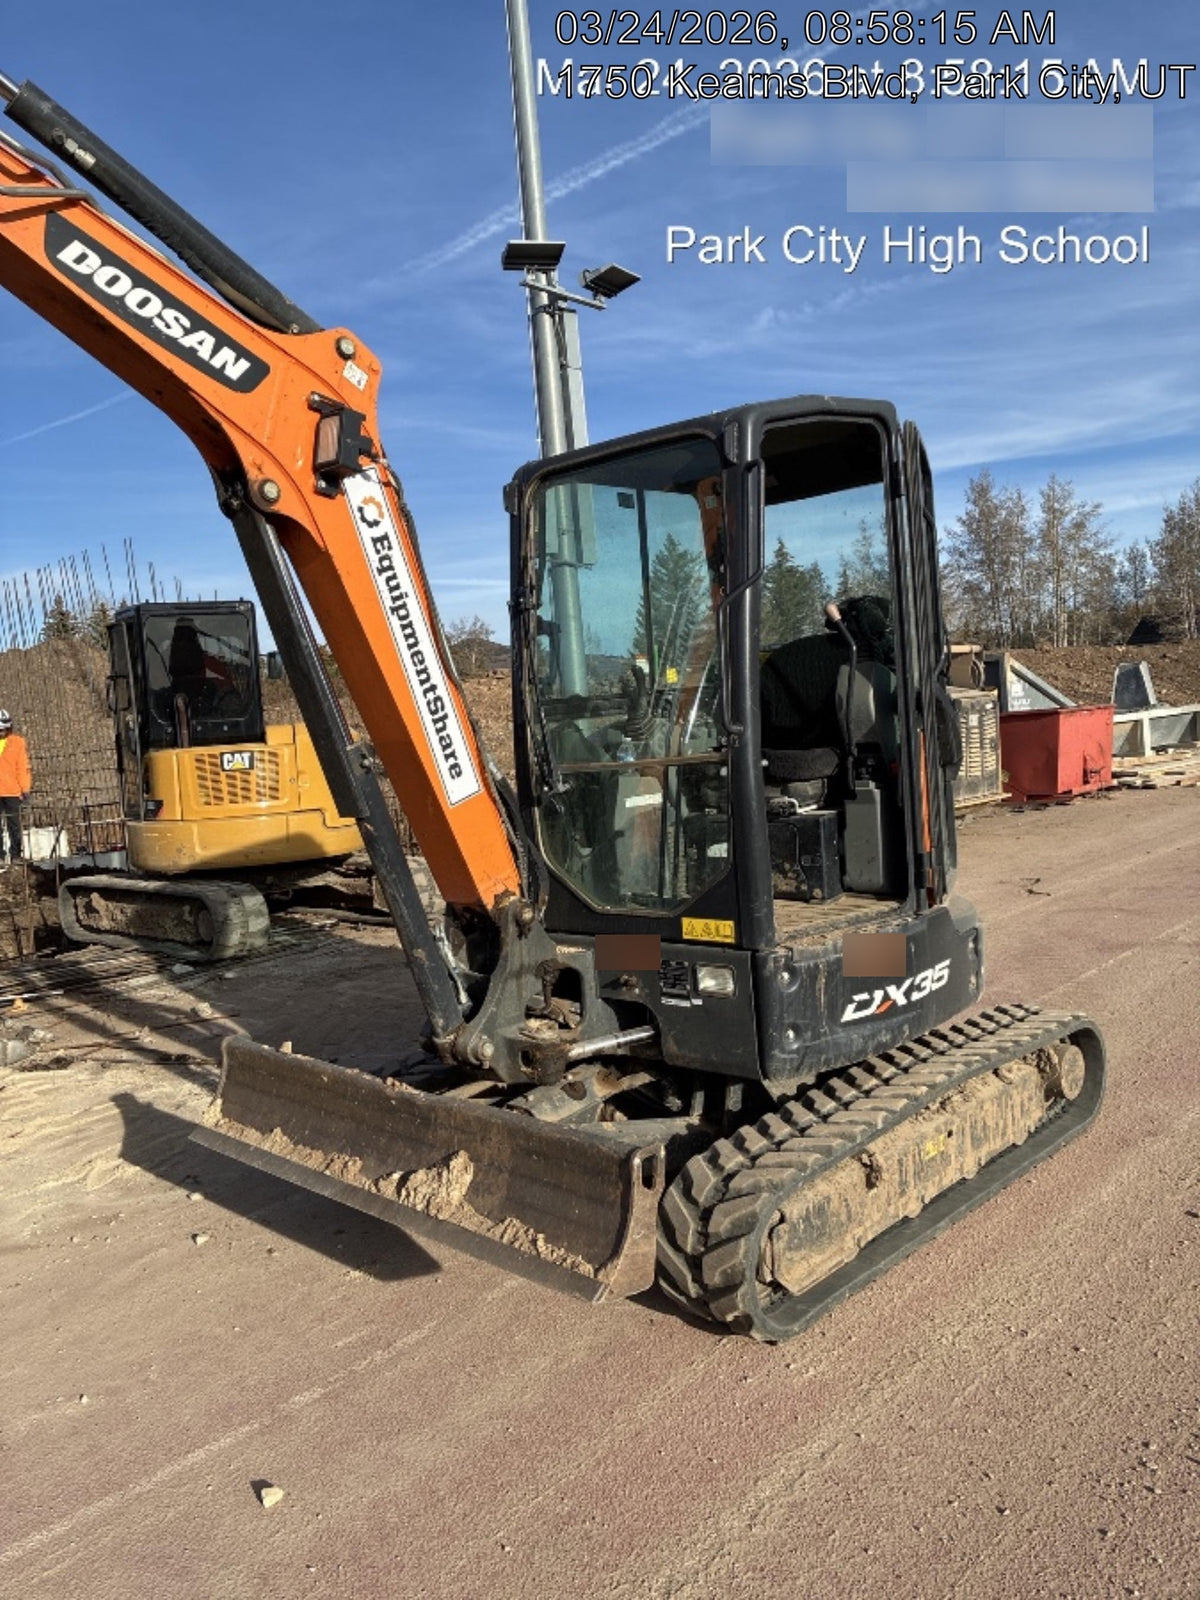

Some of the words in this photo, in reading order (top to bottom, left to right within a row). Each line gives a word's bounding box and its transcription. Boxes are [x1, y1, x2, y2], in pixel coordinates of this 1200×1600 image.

[56, 239, 251, 382] DOOSAN
[371, 531, 464, 780] EquipmentShare
[222, 751, 252, 771] CAT
[840, 957, 952, 1023] DX35
